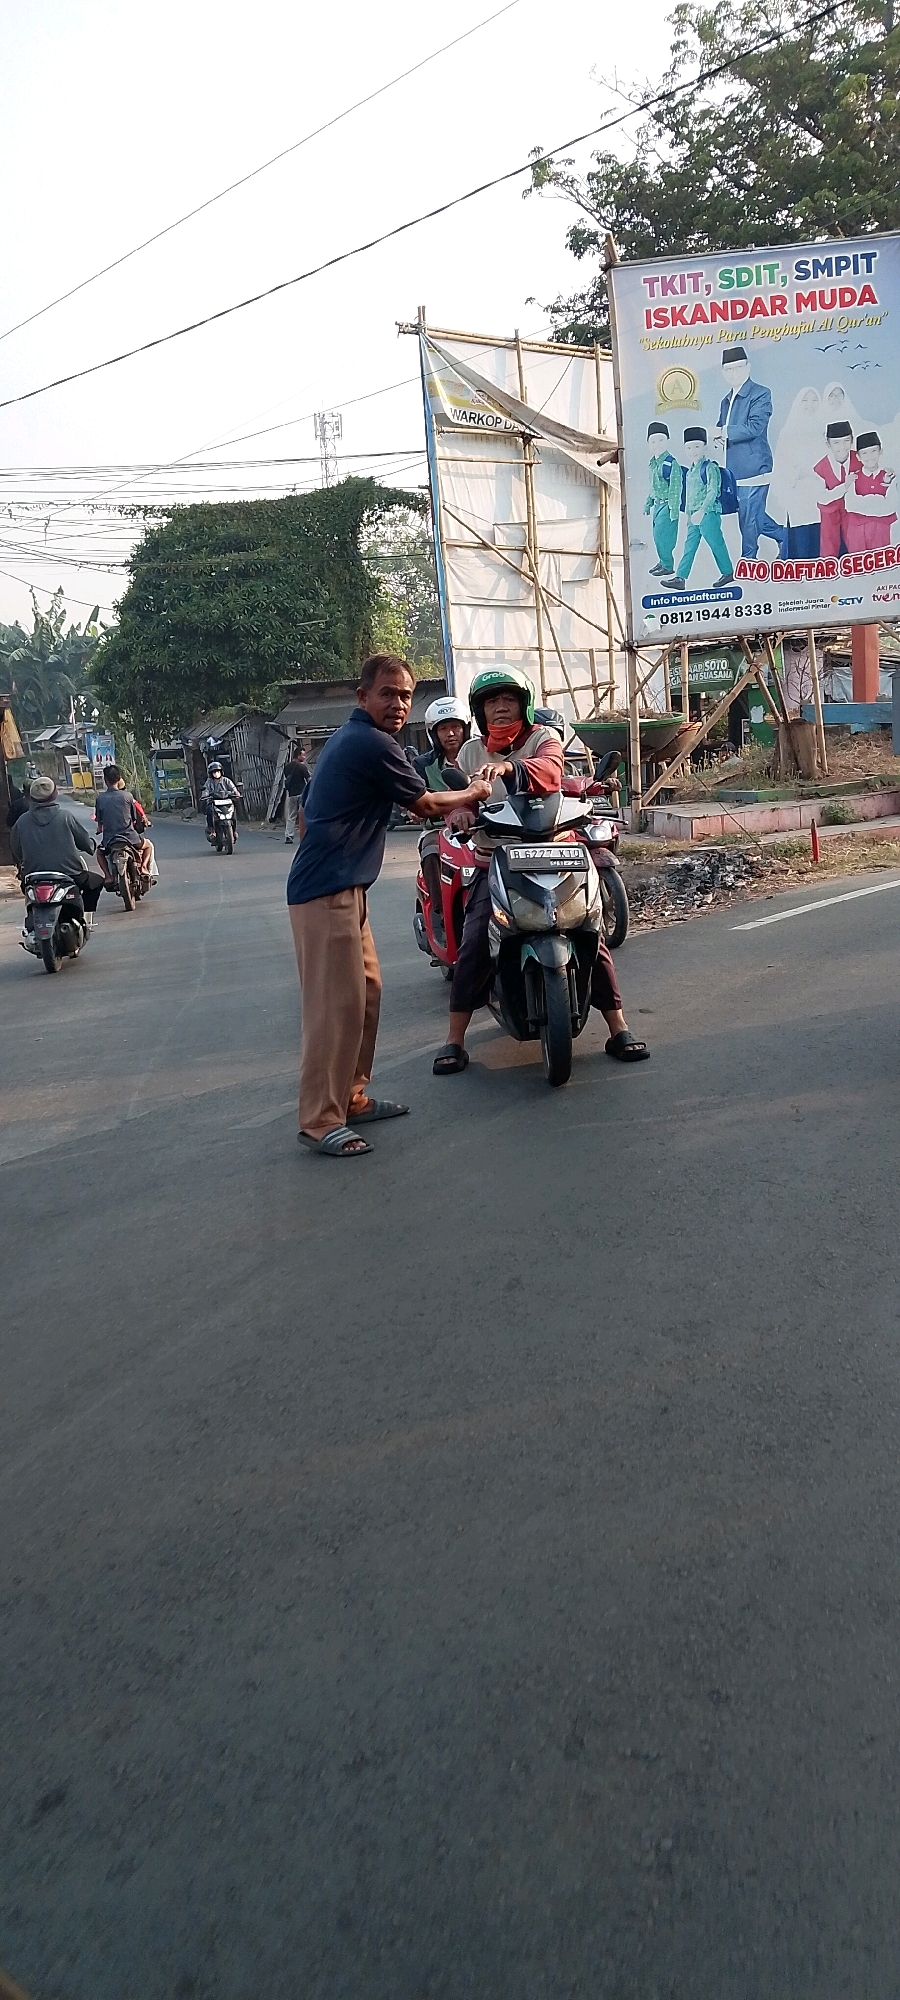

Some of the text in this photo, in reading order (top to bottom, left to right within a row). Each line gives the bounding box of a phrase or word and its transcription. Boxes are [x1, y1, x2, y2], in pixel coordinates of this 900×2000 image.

[643, 252, 877, 298] TKIT, SDIT, SMPIT
[645, 284, 879, 329] ISKANDAR MUDA
[717, 328, 748, 343] Para
[818, 317, 834, 332] Al
[450, 407, 502, 428] WARKOP
[736, 560, 769, 580] AYO
[772, 560, 838, 580] DAFTAR
[650, 597, 670, 607] Info
[837, 596, 864, 606] SCTV
[660, 602, 773, 625] 0812 1944 8338
[704, 659, 729, 671] SOTO
[481, 671, 506, 682] Grab
